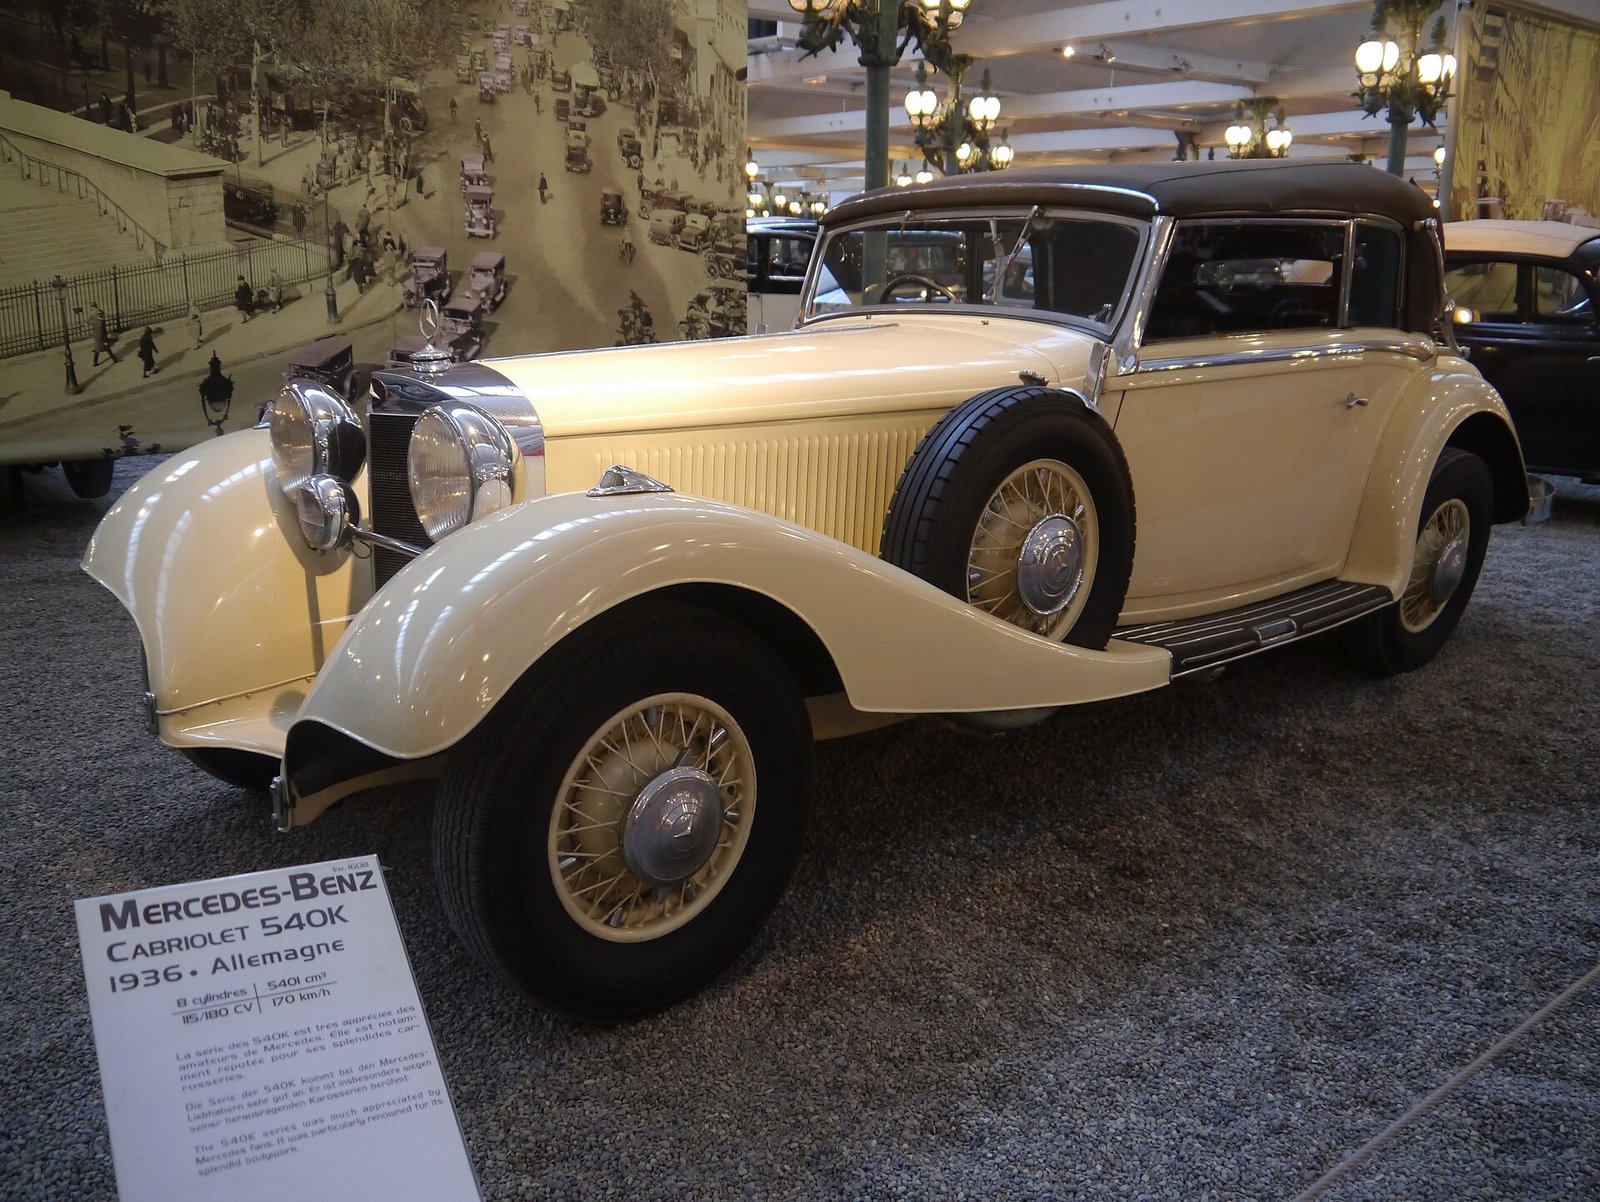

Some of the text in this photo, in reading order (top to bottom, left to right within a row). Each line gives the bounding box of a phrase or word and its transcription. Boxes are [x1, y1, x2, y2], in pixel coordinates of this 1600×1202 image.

[99, 870, 377, 932] MERCEDES-BENZ
[107, 904, 349, 962] CABRIOLET 540K
[110, 939, 345, 993] 1936 Allemagne
[268, 976, 301, 991] 5401
[177, 988, 248, 1008] 8 cylindres
[182, 1003, 253, 1025] 115/180 CV
[272, 989, 331, 1007] 170 km/h
[176, 1053, 191, 1061] La
[228, 1041, 249, 1050] des
[252, 1031, 290, 1044] 540K
[294, 1026, 311, 1036] est
[396, 1005, 415, 1015] des
[178, 1054, 238, 1071] amateurs
[243, 1049, 258, 1058] de
[330, 1029, 350, 1038] Elle
[355, 1023, 373, 1033] est
[378, 1015, 418, 1029] notam-
[180, 1068, 210, 1081] ment
[271, 1050, 299, 1063] pour
[305, 1045, 326, 1054] ses
[332, 1029, 392, 1047] splendides
[397, 1024, 421, 1034] car-
[185, 1050, 429, 1112] Die Serie der 540K kommt bei den Mercedes-
[187, 1104, 244, 1122] Liebhabern
[246, 1097, 269, 1108] sehr
[272, 1093, 289, 1104] gut
[323, 1081, 336, 1090] ist
[338, 1067, 401, 1087] insbesondere
[402, 1059, 432, 1072] wegen
[190, 1121, 220, 1133] seiner
[225, 1100, 306, 1125] herausragenden
[308, 1085, 368, 1104] Karosserien
[195, 1088, 441, 1155] The 540K series was much appreciated by
[195, 1147, 247, 1165] Mercedes
[276, 1137, 285, 1146] It
[287, 1131, 309, 1143] was
[310, 1116, 366, 1138] particularly
[367, 1106, 412, 1122] renowned
[414, 1101, 429, 1111] for
[431, 1098, 444, 1107] its
[198, 1159, 242, 1177] splendid
